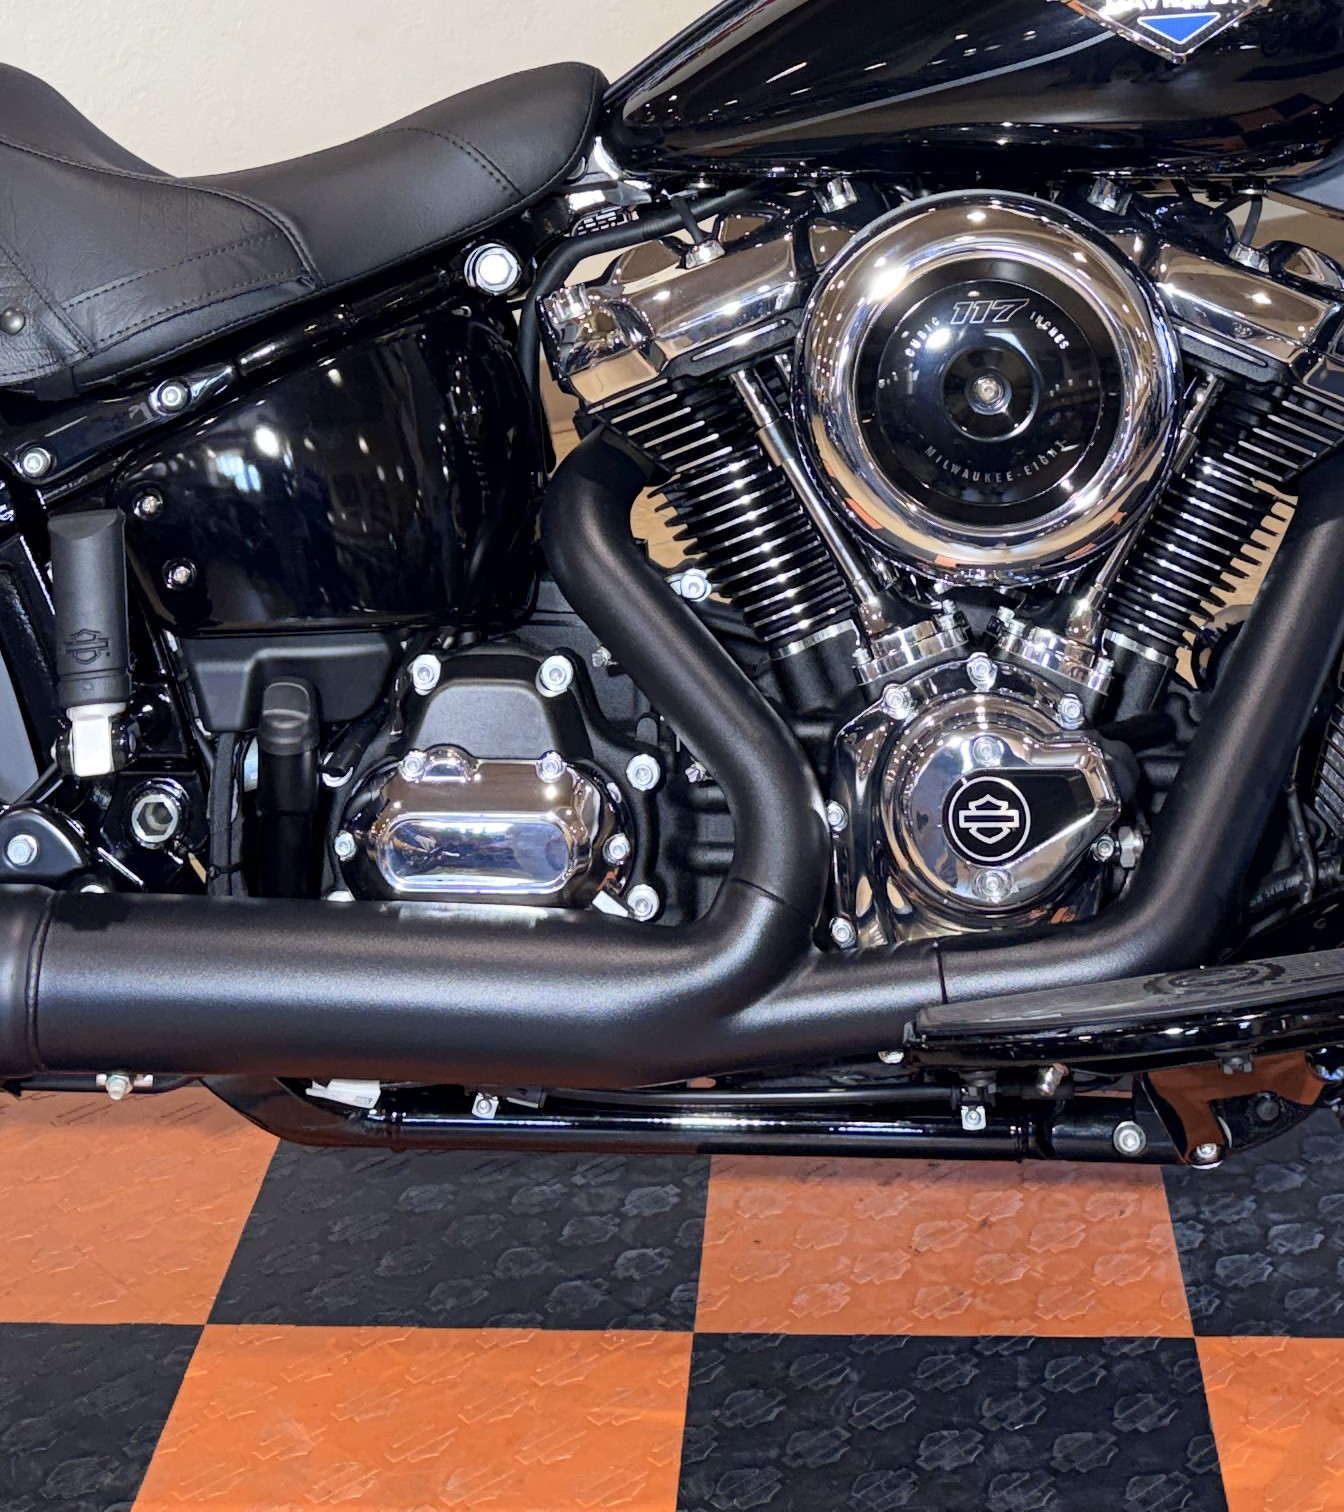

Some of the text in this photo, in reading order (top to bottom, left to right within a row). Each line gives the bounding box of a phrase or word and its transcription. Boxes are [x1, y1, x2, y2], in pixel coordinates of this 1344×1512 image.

[904, 298, 1071, 359] CUBIC 117 INCHES
[924, 439, 1068, 484] MILWAUKEE-EIGHT
